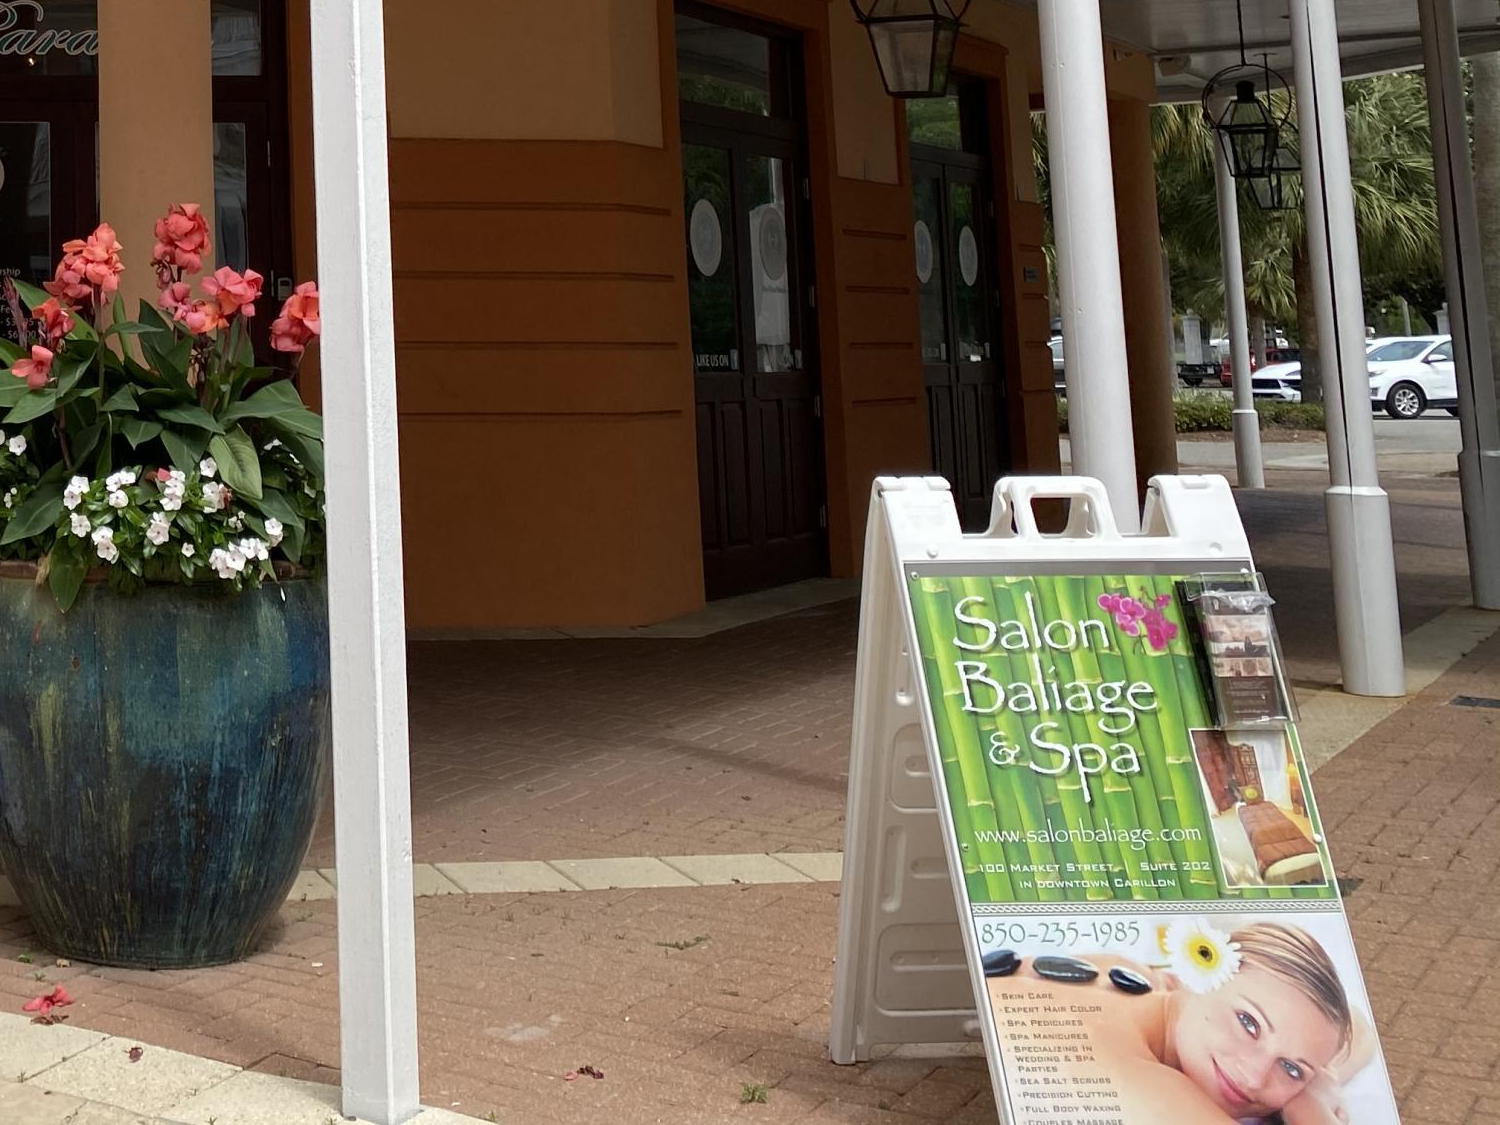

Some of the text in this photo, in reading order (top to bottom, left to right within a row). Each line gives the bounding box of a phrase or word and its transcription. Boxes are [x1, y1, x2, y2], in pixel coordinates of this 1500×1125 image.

[952, 591, 1109, 650] Salon
[954, 652, 1158, 734] Baliage
[989, 721, 1141, 803] & Spa
[974, 818, 1202, 851] www.salonbaliage.com
[979, 864, 1005, 873] 100
[1182, 861, 1212, 871] 202
[982, 921, 1140, 947] 850-235-1985
